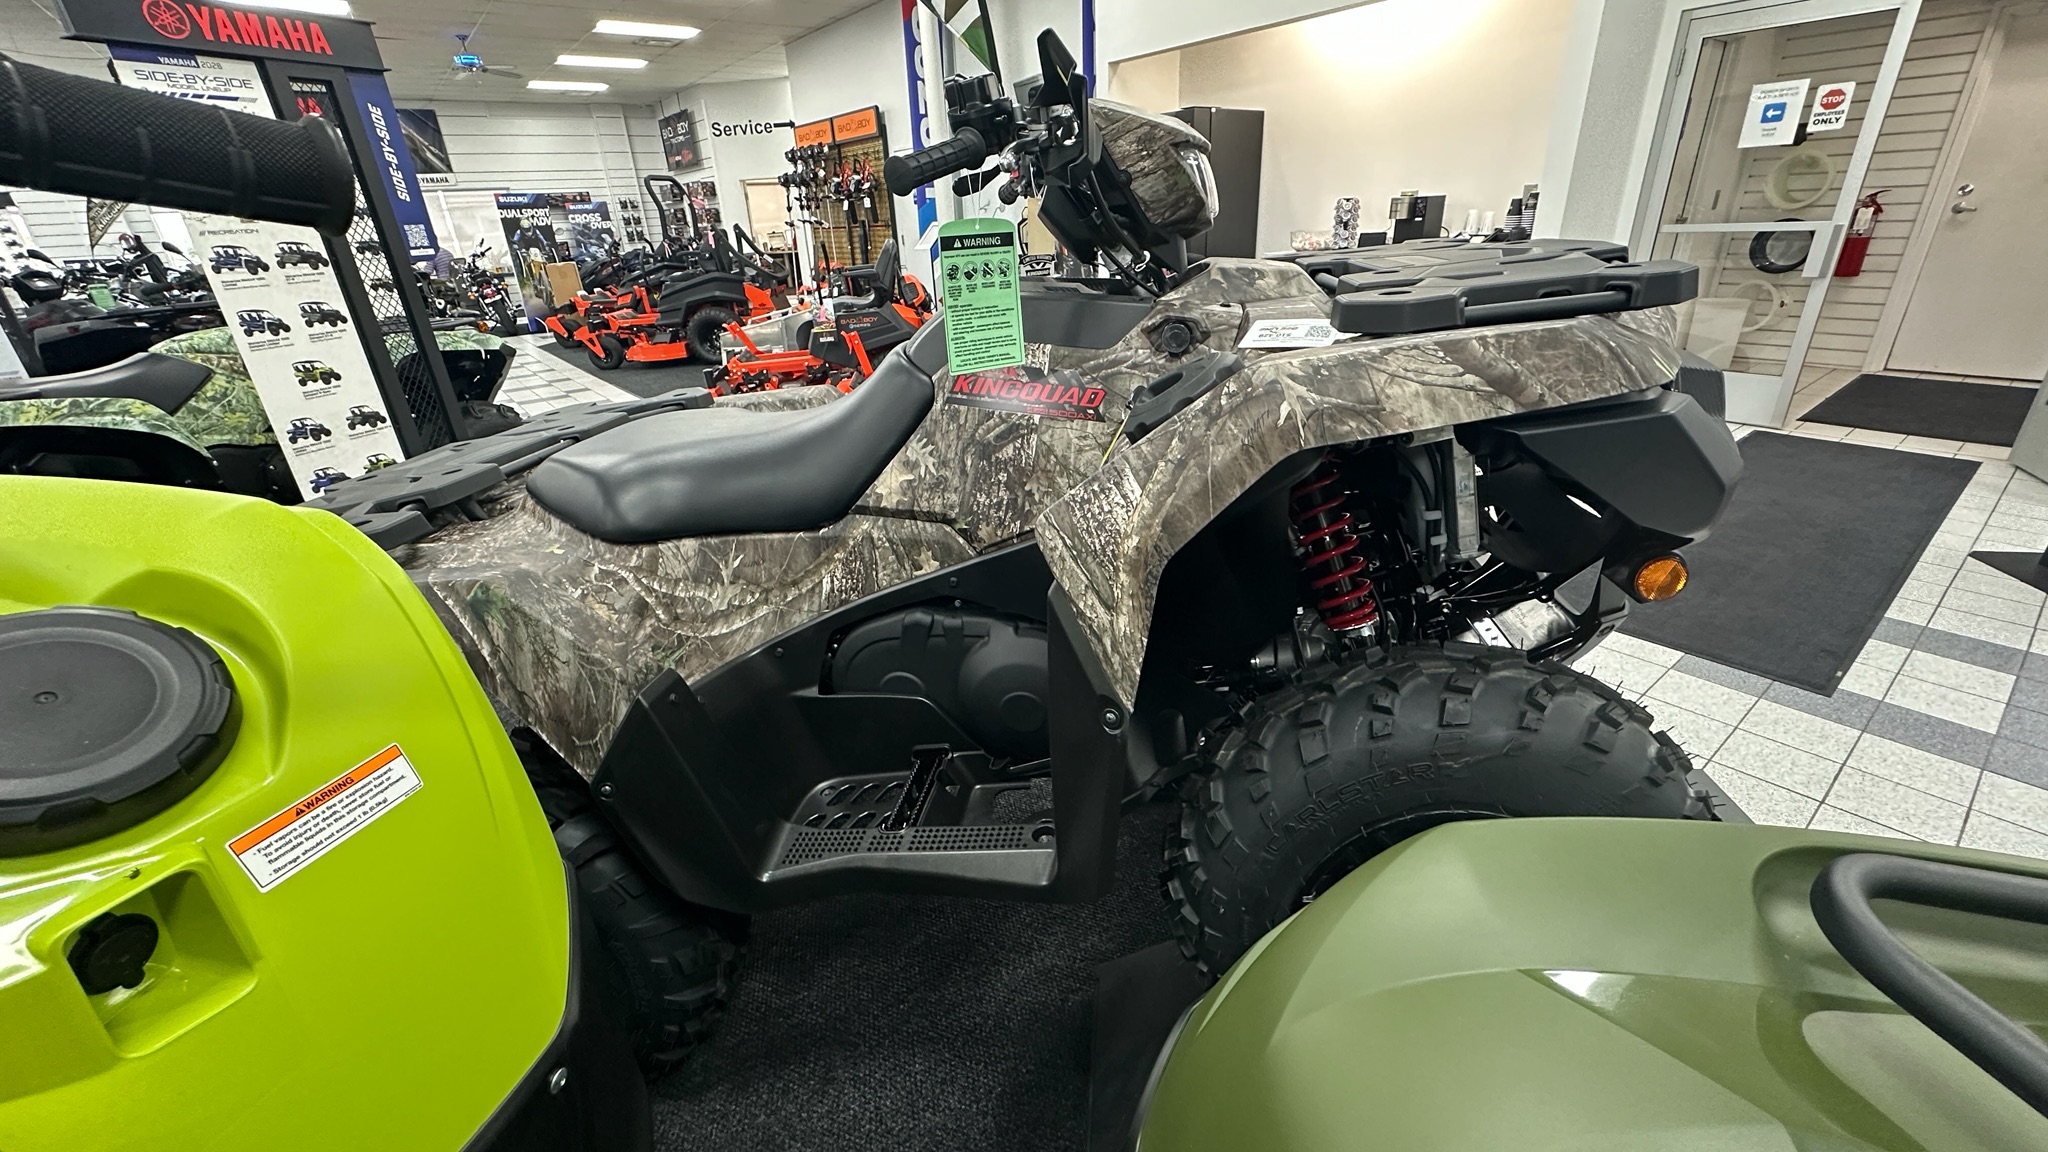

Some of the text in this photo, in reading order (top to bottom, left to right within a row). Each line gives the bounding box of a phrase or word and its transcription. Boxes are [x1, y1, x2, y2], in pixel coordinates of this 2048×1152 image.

[186, 2, 333, 55] YAMAHA
[158, 56, 198, 68] YAMAHA
[133, 69, 255, 90] SIDE-BY-SIDE
[1821, 95, 1845, 104] STOP
[1812, 116, 1842, 126] ONLY
[1813, 109, 1845, 118] EMPLOYEES
[711, 119, 773, 138] Service
[367, 102, 411, 203] SIDE-BY-SIDE
[420, 176, 450, 185] YAMAHA
[499, 208, 550, 219] DUALSPORT
[568, 213, 602, 224] CROSS
[207, 228, 259, 237] RECREATION
[590, 221, 612, 229] OVER
[963, 236, 1001, 247] WARNING
[953, 375, 1106, 408] KINGQUAD
[302, 775, 355, 811] WARNING
[256, 840, 274, 855] Fuel
[272, 825, 298, 844] vapors
[297, 817, 312, 829] can
[310, 811, 321, 821] be
[325, 801, 338, 811] fire
[336, 796, 345, 804] or
[343, 778, 373, 800] explosion
[371, 765, 394, 782] hazard.
[262, 774, 392, 860] To avoid injury or death, never store fuel or
[267, 839, 305, 866] flammable
[303, 825, 327, 843] liquids
[325, 820, 334, 828] in
[332, 812, 346, 824] this
[345, 798, 369, 816] storage
[367, 773, 407, 801] compartment.
[272, 854, 302, 875] Storage
[300, 838, 324, 857] should
[322, 831, 336, 842] not
[334, 816, 358, 834] exceed
[361, 809, 369, 817] lb
